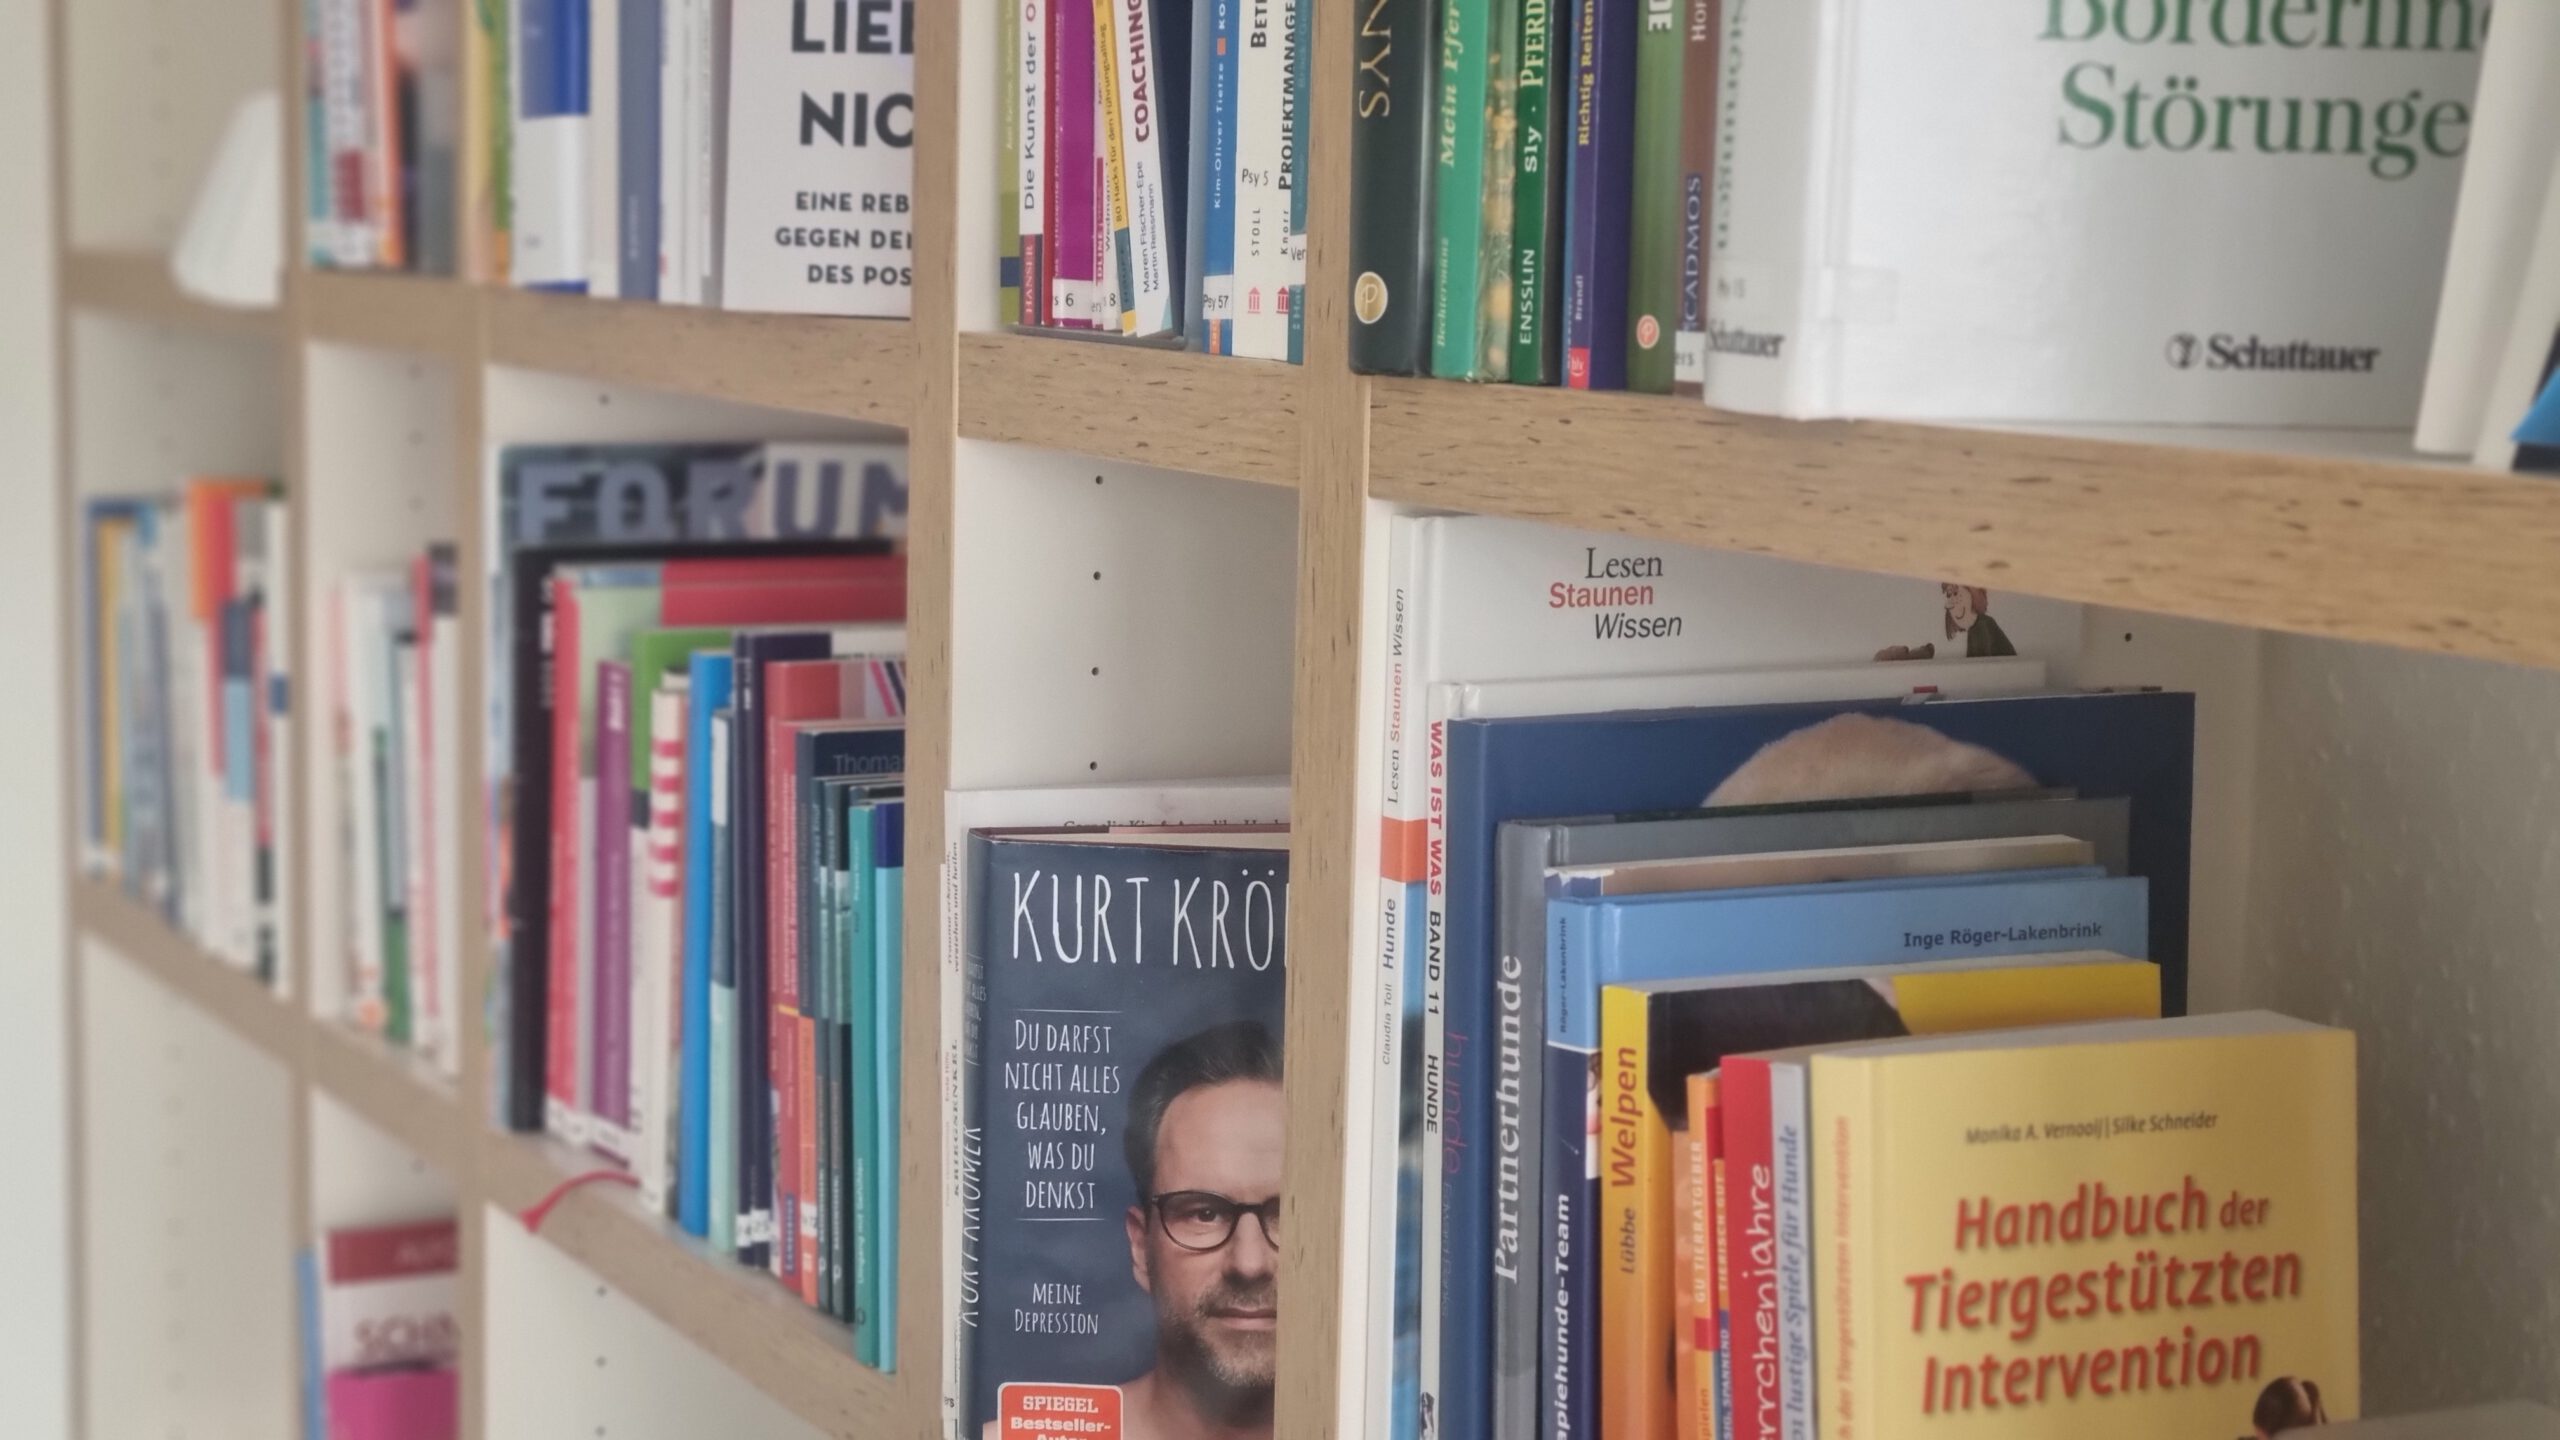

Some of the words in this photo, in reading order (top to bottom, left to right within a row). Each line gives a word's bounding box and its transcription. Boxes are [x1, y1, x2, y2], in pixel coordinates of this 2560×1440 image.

[792, 0, 914, 54] LIE
[1250, 0, 1268, 48] BET
[1580, 0, 1595, 66] Reiten
[1025, 33, 1036, 75] der
[1216, 63, 1225, 114] Tietze
[1579, 72, 1595, 145] Richtig
[1025, 83, 1036, 159] Kunst
[1107, 116, 1116, 141] den
[1440, 83, 1457, 168] Mein
[1108, 144, 1118, 162] für
[1213, 121, 1224, 209] Kim-Oliver
[1241, 167, 1260, 187] Psy
[796, 191, 851, 212] EINE
[861, 193, 909, 214] REB
[1024, 169, 1035, 210] Die
[1110, 165, 1121, 202] Hacks
[1135, 161, 1147, 245] Fischer-Epe
[775, 226, 859, 248] GEGEN
[1114, 205, 1122, 223] 80
[1146, 183, 1157, 250] Reissmann
[1251, 207, 1261, 257] STOLL
[1280, 209, 1289, 255] Knorr
[1140, 248, 1151, 294] Maren
[1149, 252, 1159, 291] Martin
[1684, 175, 1700, 321] CADMOS
[807, 264, 854, 284] DES
[863, 266, 911, 286] POS
[1025, 245, 1034, 313] HANSER
[1519, 248, 1536, 344] ENSSLIN
[1218, 294, 1229, 309] 57
[2205, 333, 2381, 374] Schattauer
[1585, 547, 1664, 579] Lesen
[1549, 581, 1654, 610] Staunen
[1392, 587, 1405, 657] Wissen
[1593, 612, 1683, 641] Wissen
[1390, 662, 1403, 742] Staunen
[1430, 719, 1444, 778] WAS
[1387, 748, 1401, 804] Lesen
[1430, 787, 1443, 830] IST
[1429, 838, 1442, 897] WAS
[1012, 870, 1150, 965] KURT
[1172, 868, 1290, 972] KRÖ
[1382, 898, 1397, 970] Hunde
[1903, 931, 1945, 950] Inge
[1950, 920, 2103, 947] Röger-Lakenbrink
[1428, 910, 1442, 982] BAND
[1384, 983, 1393, 1008] Toll
[1559, 916, 1570, 1034] Röger-Lakenbrink
[1427, 991, 1440, 1015] 11
[1014, 1018, 1040, 1052] DU
[1046, 1023, 1112, 1055] DARFST
[1382, 1012, 1393, 1065] Claudia
[1005, 1061, 1063, 1092] NICHT
[1070, 1064, 1121, 1095] ALLES
[1426, 1054, 1439, 1135] HUNDE
[1016, 1100, 1107, 1136] GLAUBEN,
[1495, 954, 1522, 1286] Partnerhunde
[1609, 1046, 1644, 1188] Welpen
[1965, 1126, 2022, 1145] Monika
[2025, 1123, 2040, 1141] A.
[2112, 1114, 2147, 1137] Silke
[2149, 1109, 2218, 1134] Schneider
[1027, 1140, 1065, 1171] WAS
[1071, 1141, 1095, 1173] DU
[1778, 1125, 1800, 1206] Hunde
[1025, 1180, 1096, 1211] DENKST
[1690, 1140, 1705, 1271] TIERRATGEBER
[1714, 1173, 1726, 1208] GUT
[1954, 1174, 2207, 1251] Handbuch
[2219, 1192, 2270, 1229] der
[1619, 1206, 1637, 1275] Lübbe
[1715, 1214, 1728, 1292] TIERISCH
[1780, 1211, 1807, 1252] für
[1032, 1282, 1083, 1306] MEINE
[1693, 1278, 1707, 1303] GU
[1781, 1255, 1807, 1328] Spiele
[1905, 1248, 2303, 1341] Tiergestützten
[1014, 1308, 1099, 1335] DEPRESSION
[1785, 1332, 1807, 1414] lustige
[1922, 1324, 2261, 1416] Intervention
[1010, 1416, 1111, 1433] Bestseller-
[1022, 1395, 1099, 1414] SPIEGEL
